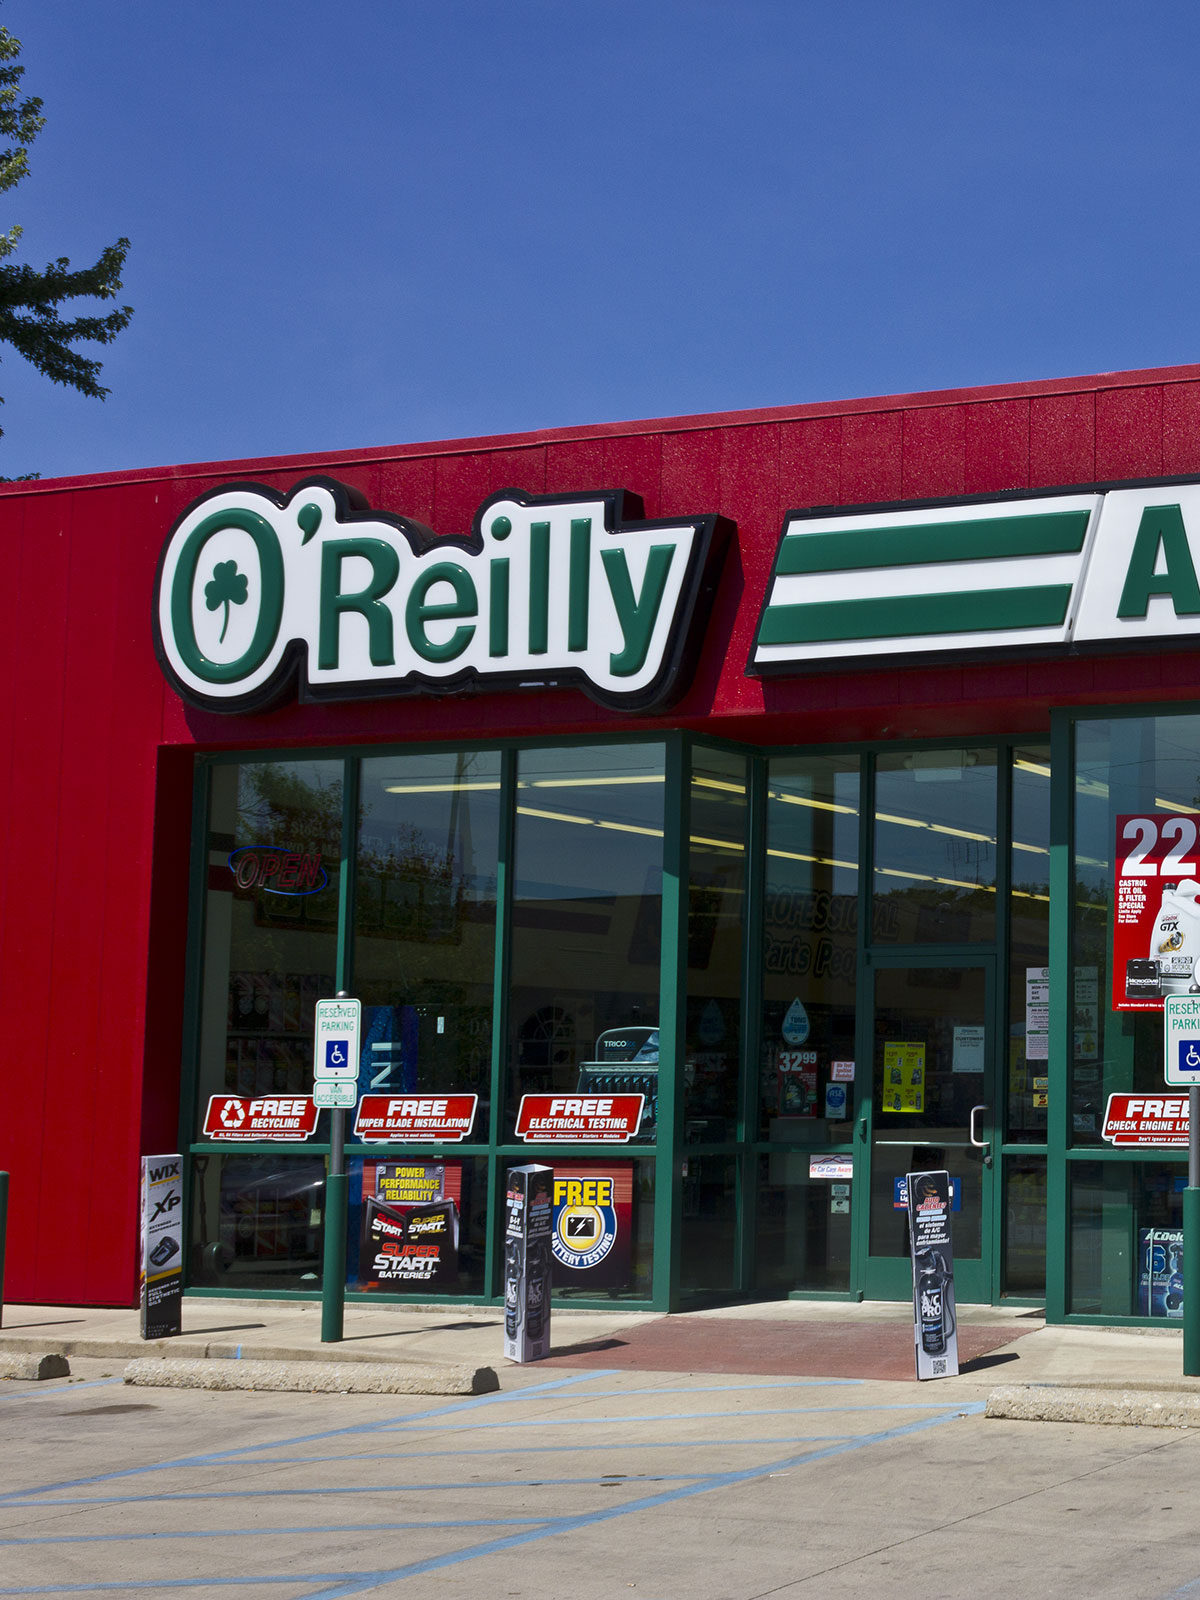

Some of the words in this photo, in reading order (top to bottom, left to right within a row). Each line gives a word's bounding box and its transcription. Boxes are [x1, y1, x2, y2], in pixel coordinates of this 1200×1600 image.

[171, 503, 676, 684] O'Reilly
[236, 853, 322, 888] OPEN
[1119, 879, 1147, 887] CASTROL
[1160, 921, 1179, 932] GTX
[320, 1008, 356, 1018] RESERVED
[321, 1021, 354, 1031] PARKING
[603, 1040, 627, 1048] TRICO
[248, 1100, 307, 1116] FREE
[387, 1100, 448, 1116] FREE
[549, 1099, 613, 1116] FREE
[251, 1118, 300, 1128] RECYCLING
[358, 1118, 384, 1128] WIPER
[386, 1118, 412, 1128] BLADE
[414, 1118, 470, 1128] INSTALLATION
[529, 1118, 585, 1129] ELECTRICAL
[588, 1118, 628, 1129] TESTING
[1107, 1120, 1137, 1131] CHECK
[1139, 1120, 1173, 1131] ENGINE
[149, 1162, 179, 1183] WIX
[395, 1167, 425, 1178] POWER
[380, 1179, 440, 1189] PERFORMANCE
[386, 1190, 434, 1201] RELIABILITY
[553, 1181, 611, 1207] FREE
[149, 1189, 181, 1223] XP
[371, 1218, 403, 1237] START
[408, 1221, 445, 1233] START
[381, 1242, 440, 1257] SUPER
[582, 1232, 613, 1266] TESTING
[372, 1254, 441, 1271] START
[378, 1271, 432, 1279] BATTERIES
